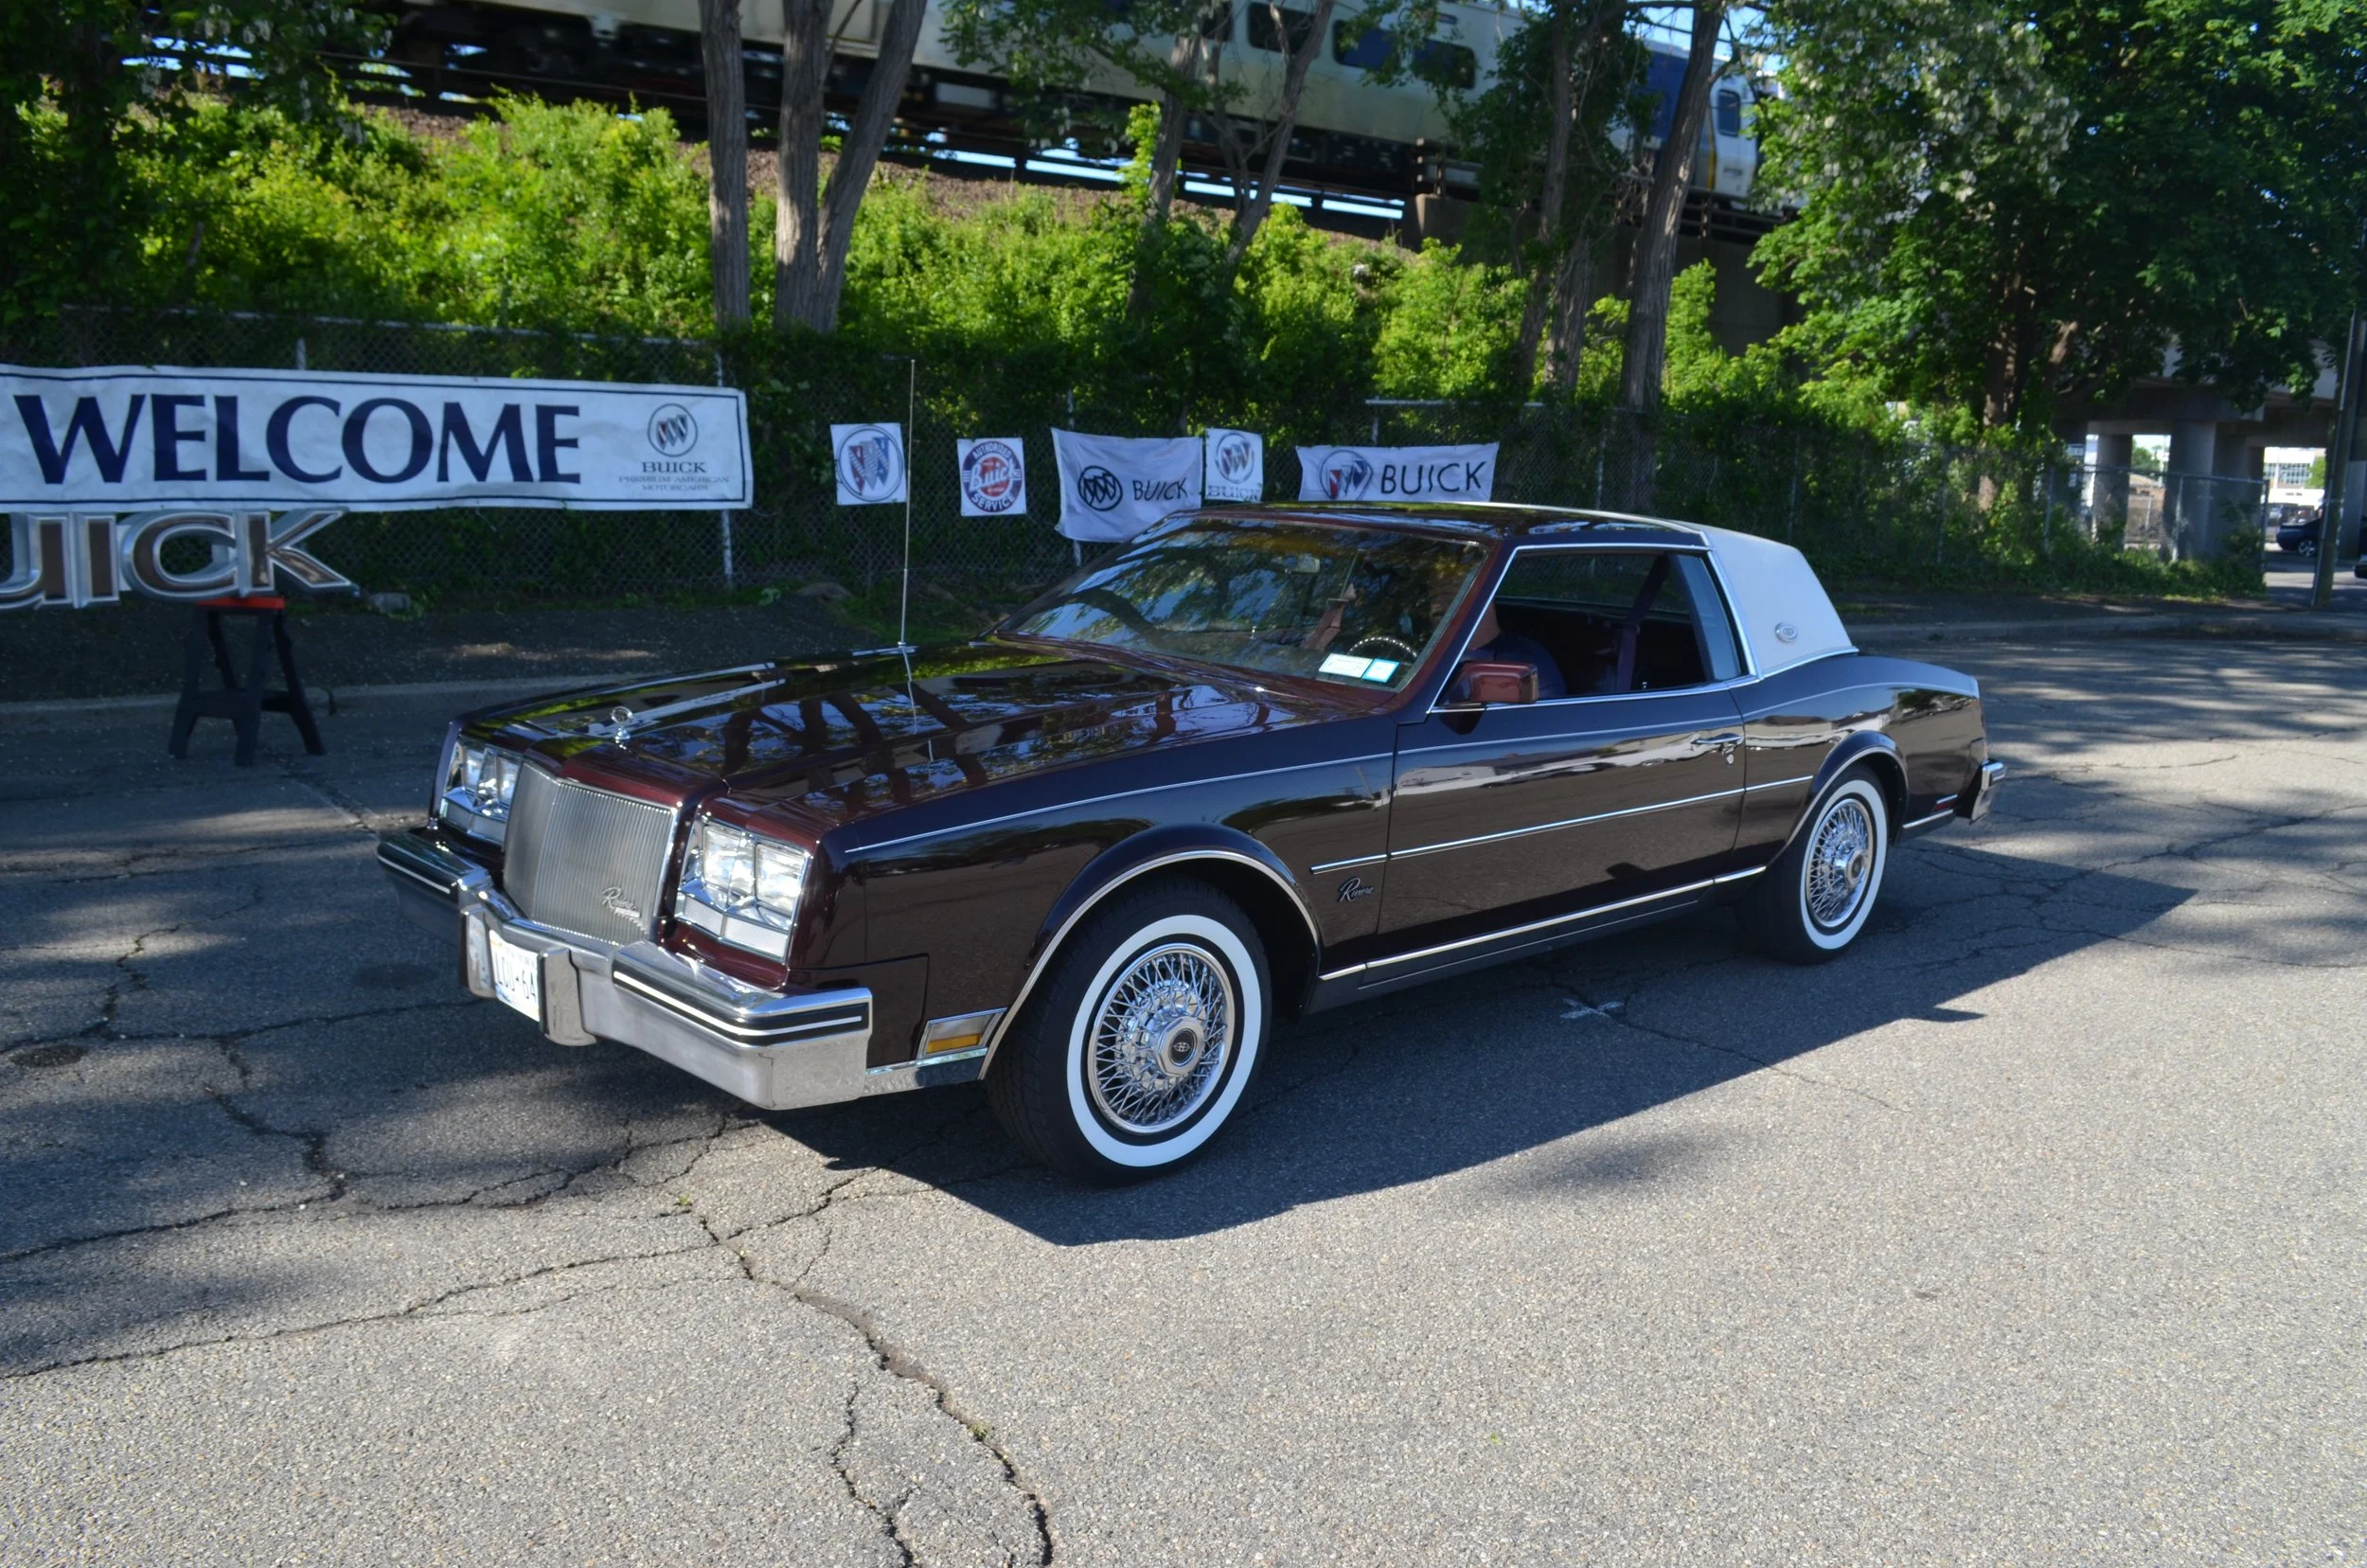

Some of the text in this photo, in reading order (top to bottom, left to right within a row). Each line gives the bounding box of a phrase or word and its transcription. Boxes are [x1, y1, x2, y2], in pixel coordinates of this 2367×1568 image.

[13, 393, 581, 485] WELCOME
[641, 461, 707, 473] BUICK
[969, 458, 1020, 492] Buick
[1379, 461, 1486, 495] BUICK
[1132, 477, 1188, 501] BUICK
[1207, 485, 1261, 502] BUICK
[971, 492, 1016, 511] SERVICE
